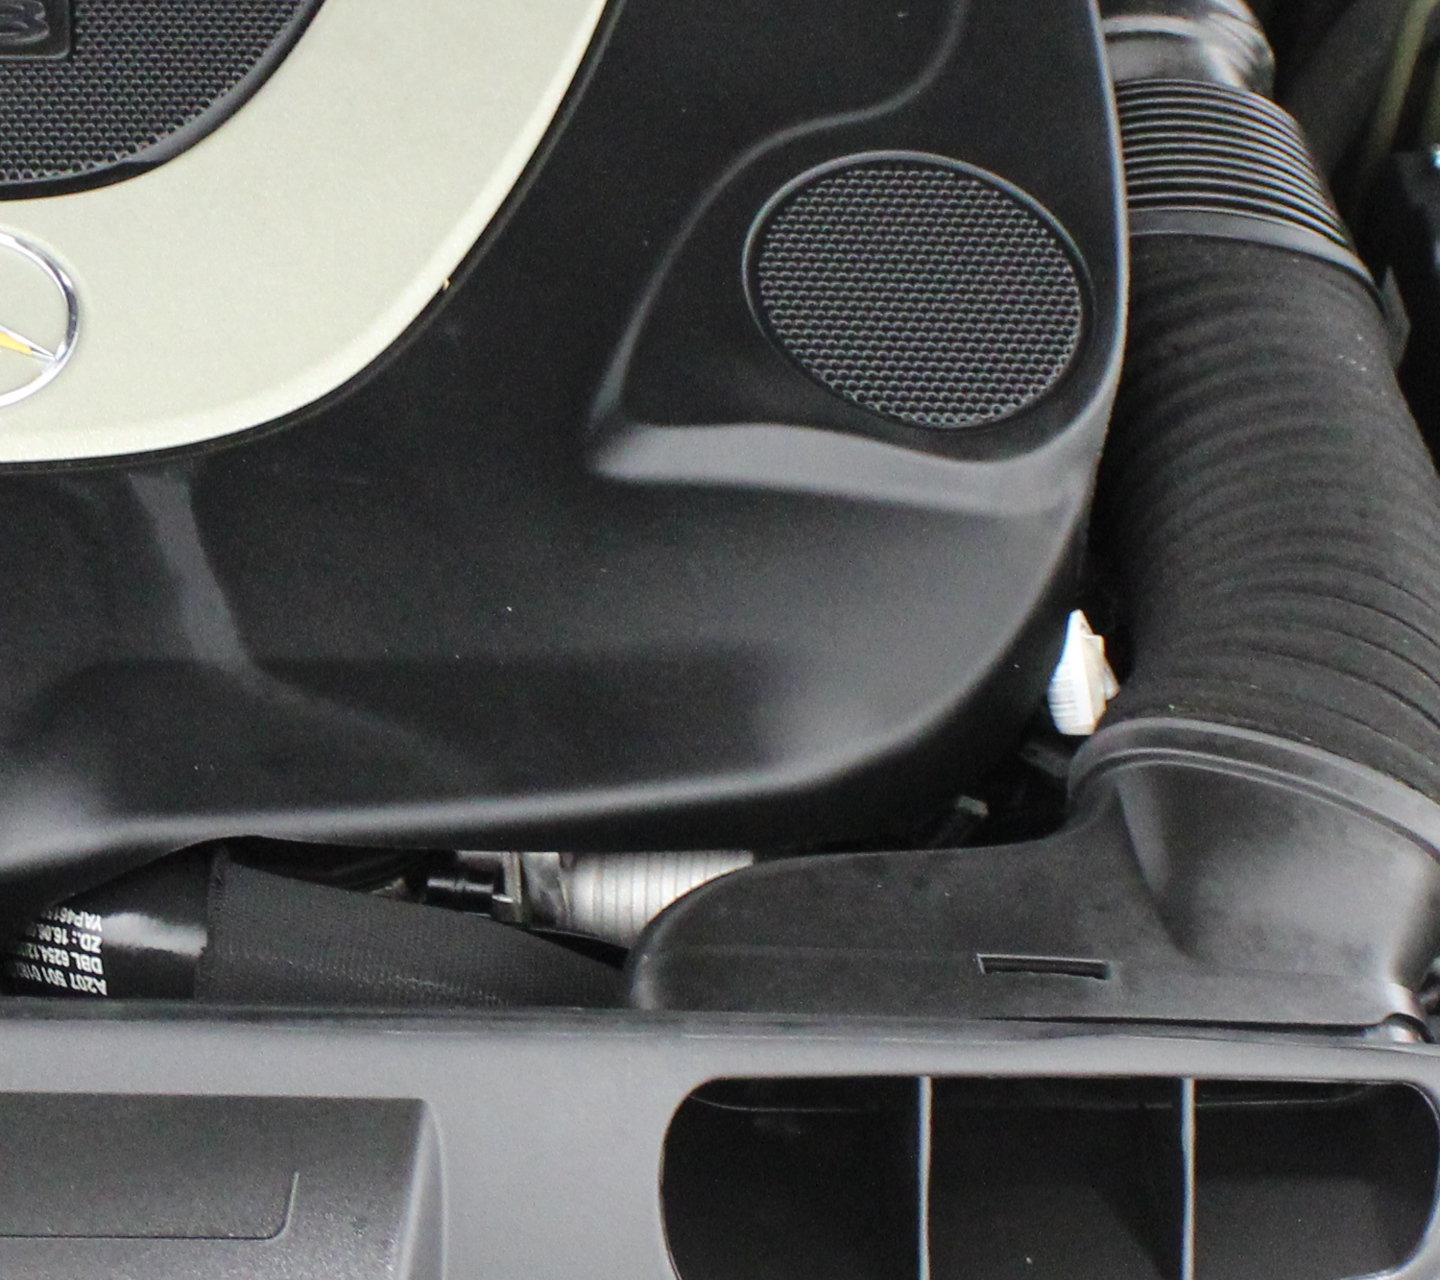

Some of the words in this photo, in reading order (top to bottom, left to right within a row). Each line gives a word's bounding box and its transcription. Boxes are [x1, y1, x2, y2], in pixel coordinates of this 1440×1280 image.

[70, 951, 103, 975] DBL
[41, 966, 68, 989] 501
[69, 972, 108, 996] A207
